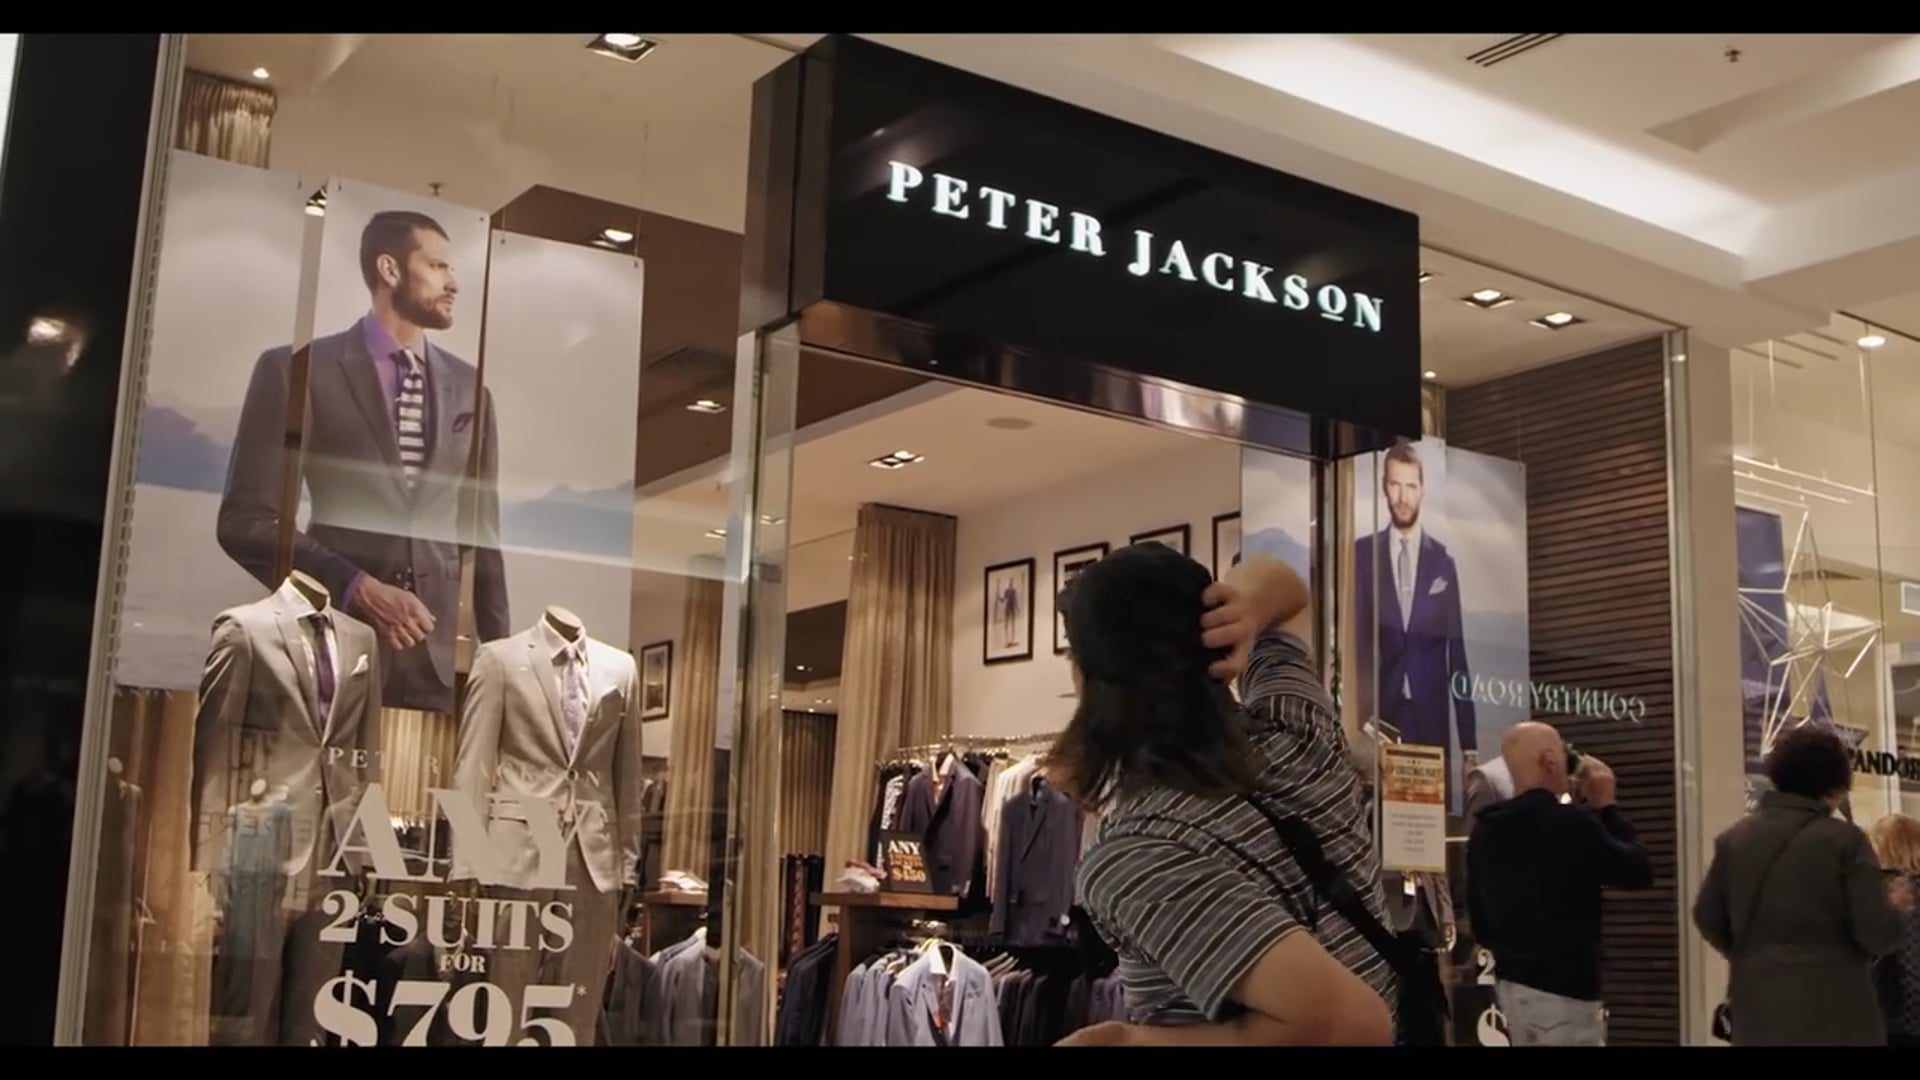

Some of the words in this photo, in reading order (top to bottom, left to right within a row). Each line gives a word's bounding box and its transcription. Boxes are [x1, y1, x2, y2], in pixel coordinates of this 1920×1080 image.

[888, 161, 1106, 257] PETER
[1128, 230, 1384, 333] JACKSON
[327, 746, 439, 775] PETR
[317, 782, 599, 890] ANY
[888, 840, 920, 855] ANY
[319, 890, 360, 942] 2
[380, 891, 574, 952] SUITS
[440, 953, 486, 973] FOR
